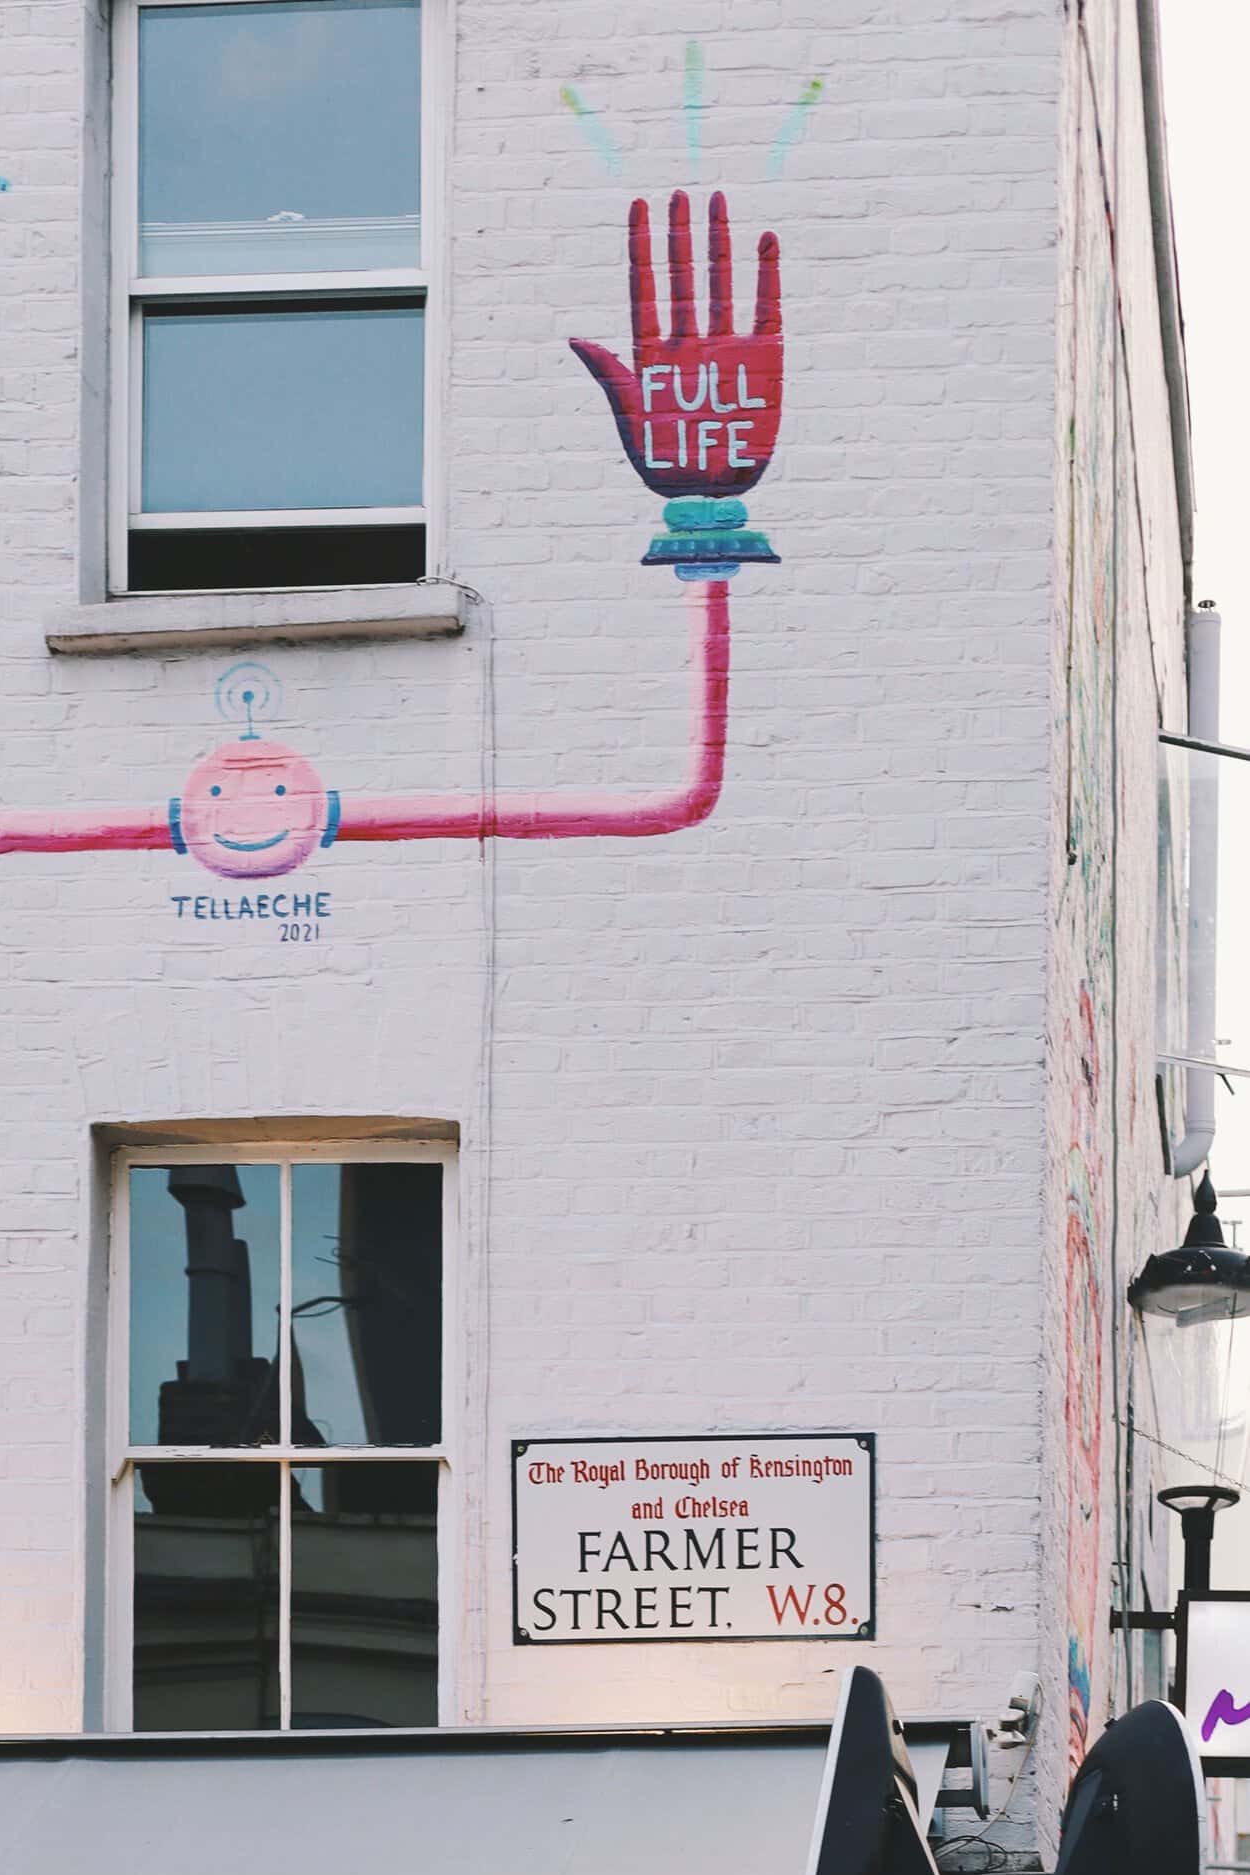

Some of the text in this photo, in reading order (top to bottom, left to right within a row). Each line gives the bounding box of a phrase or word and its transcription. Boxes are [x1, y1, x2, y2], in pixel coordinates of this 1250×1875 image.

[642, 361, 767, 413] FULL
[644, 419, 756, 471] LIFE
[171, 892, 331, 920] TELLAECHE
[278, 923, 320, 942] 2021
[528, 1454, 854, 1489] The Royal Borough of Kensington
[630, 1495, 750, 1520] and Chelsea
[577, 1527, 805, 1573] FARMER
[766, 1583, 859, 1627] W.8.
